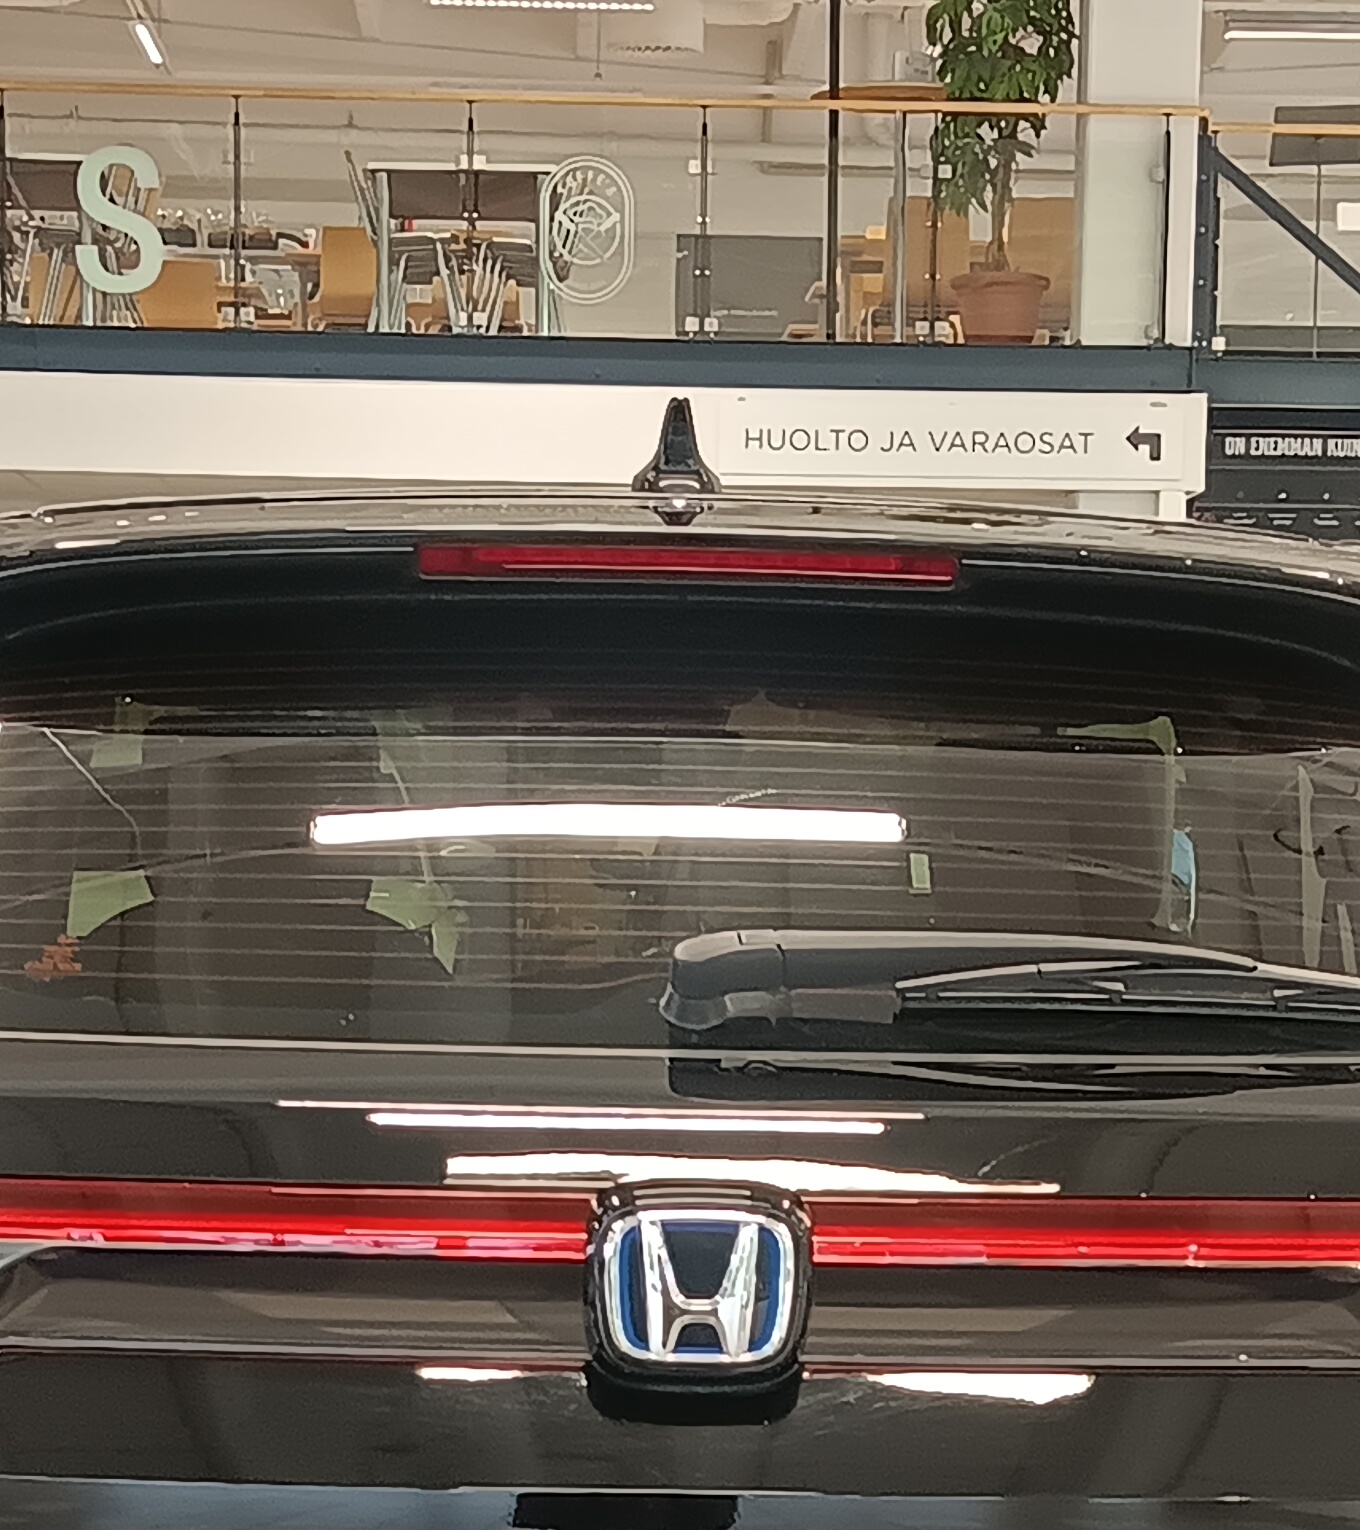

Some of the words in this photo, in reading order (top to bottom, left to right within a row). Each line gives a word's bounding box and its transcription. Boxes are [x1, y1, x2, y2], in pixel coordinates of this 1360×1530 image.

[745, 428, 869, 452] HUOLTO
[880, 430, 917, 452] JA
[928, 430, 1094, 454] VARAOSAT
